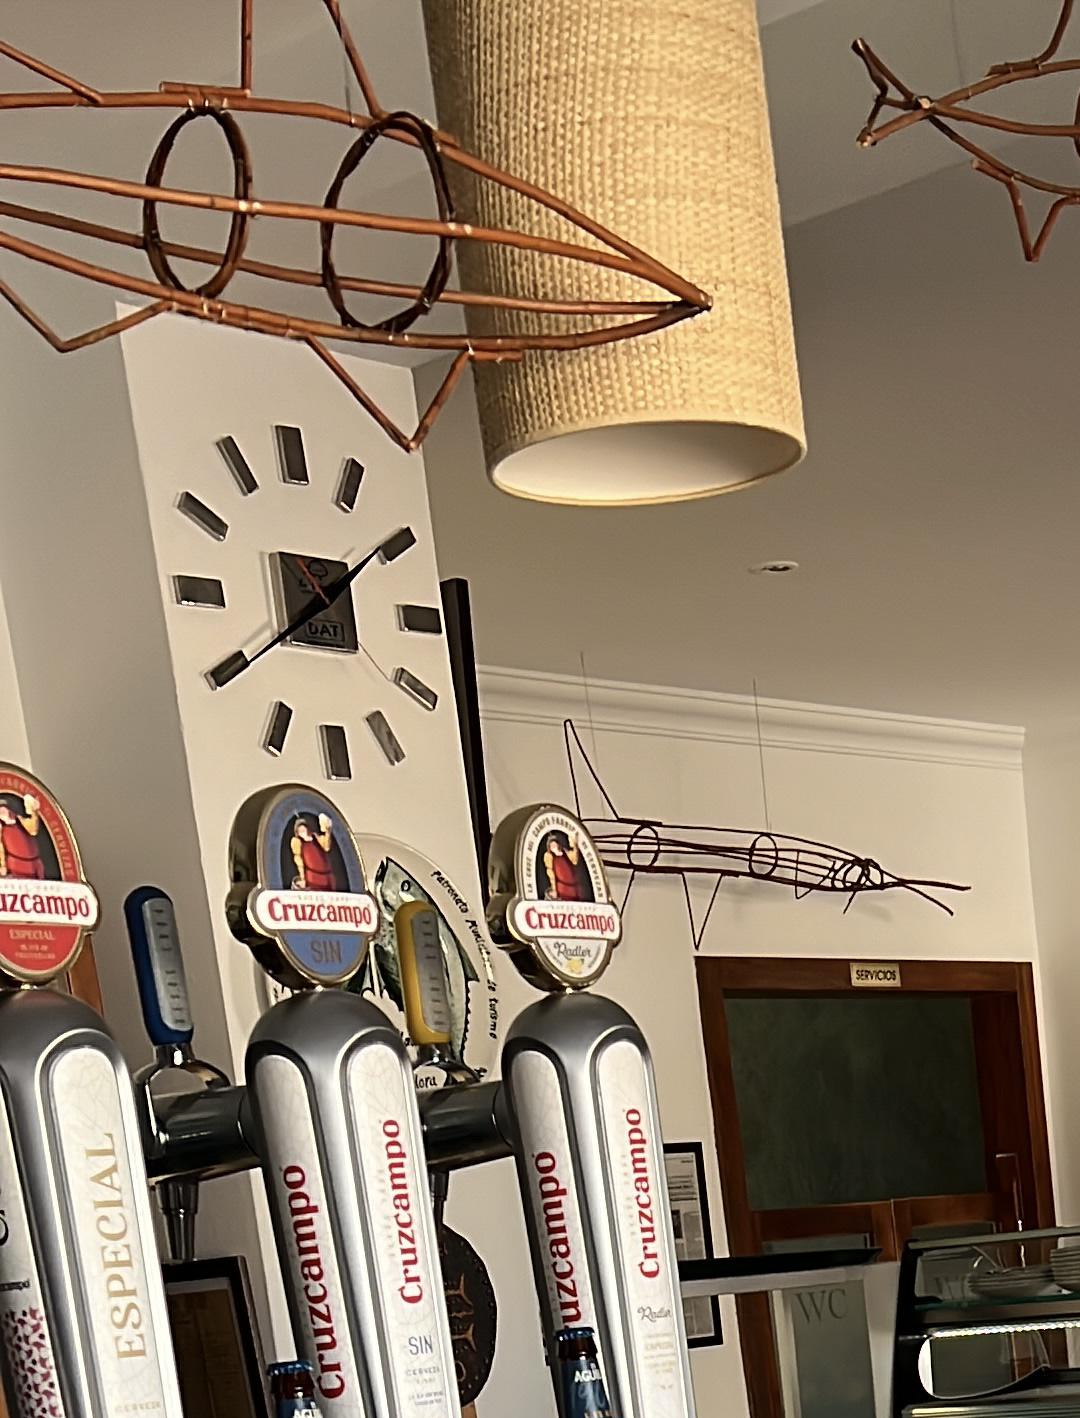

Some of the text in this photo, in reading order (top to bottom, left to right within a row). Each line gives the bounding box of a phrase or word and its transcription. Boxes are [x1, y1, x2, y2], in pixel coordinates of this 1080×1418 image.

[430, 869, 469, 914] Patronato
[268, 897, 371, 928] Cruzcampo
[525, 906, 615, 935] Cruzcampo
[310, 939, 342, 964] SIN
[553, 941, 592, 960] Radler
[856, 969, 897, 981] SERVICIOS
[625, 1108, 660, 1279] Cruzcampo
[382, 1119, 423, 1304] Cruzcampo
[85, 1132, 147, 1359] ESPECIAL
[534, 1151, 582, 1328] uzcampo
[283, 1165, 346, 1399] Cruzcampo
[793, 1288, 846, 1323] WC
[408, 1335, 434, 1355] SIN
